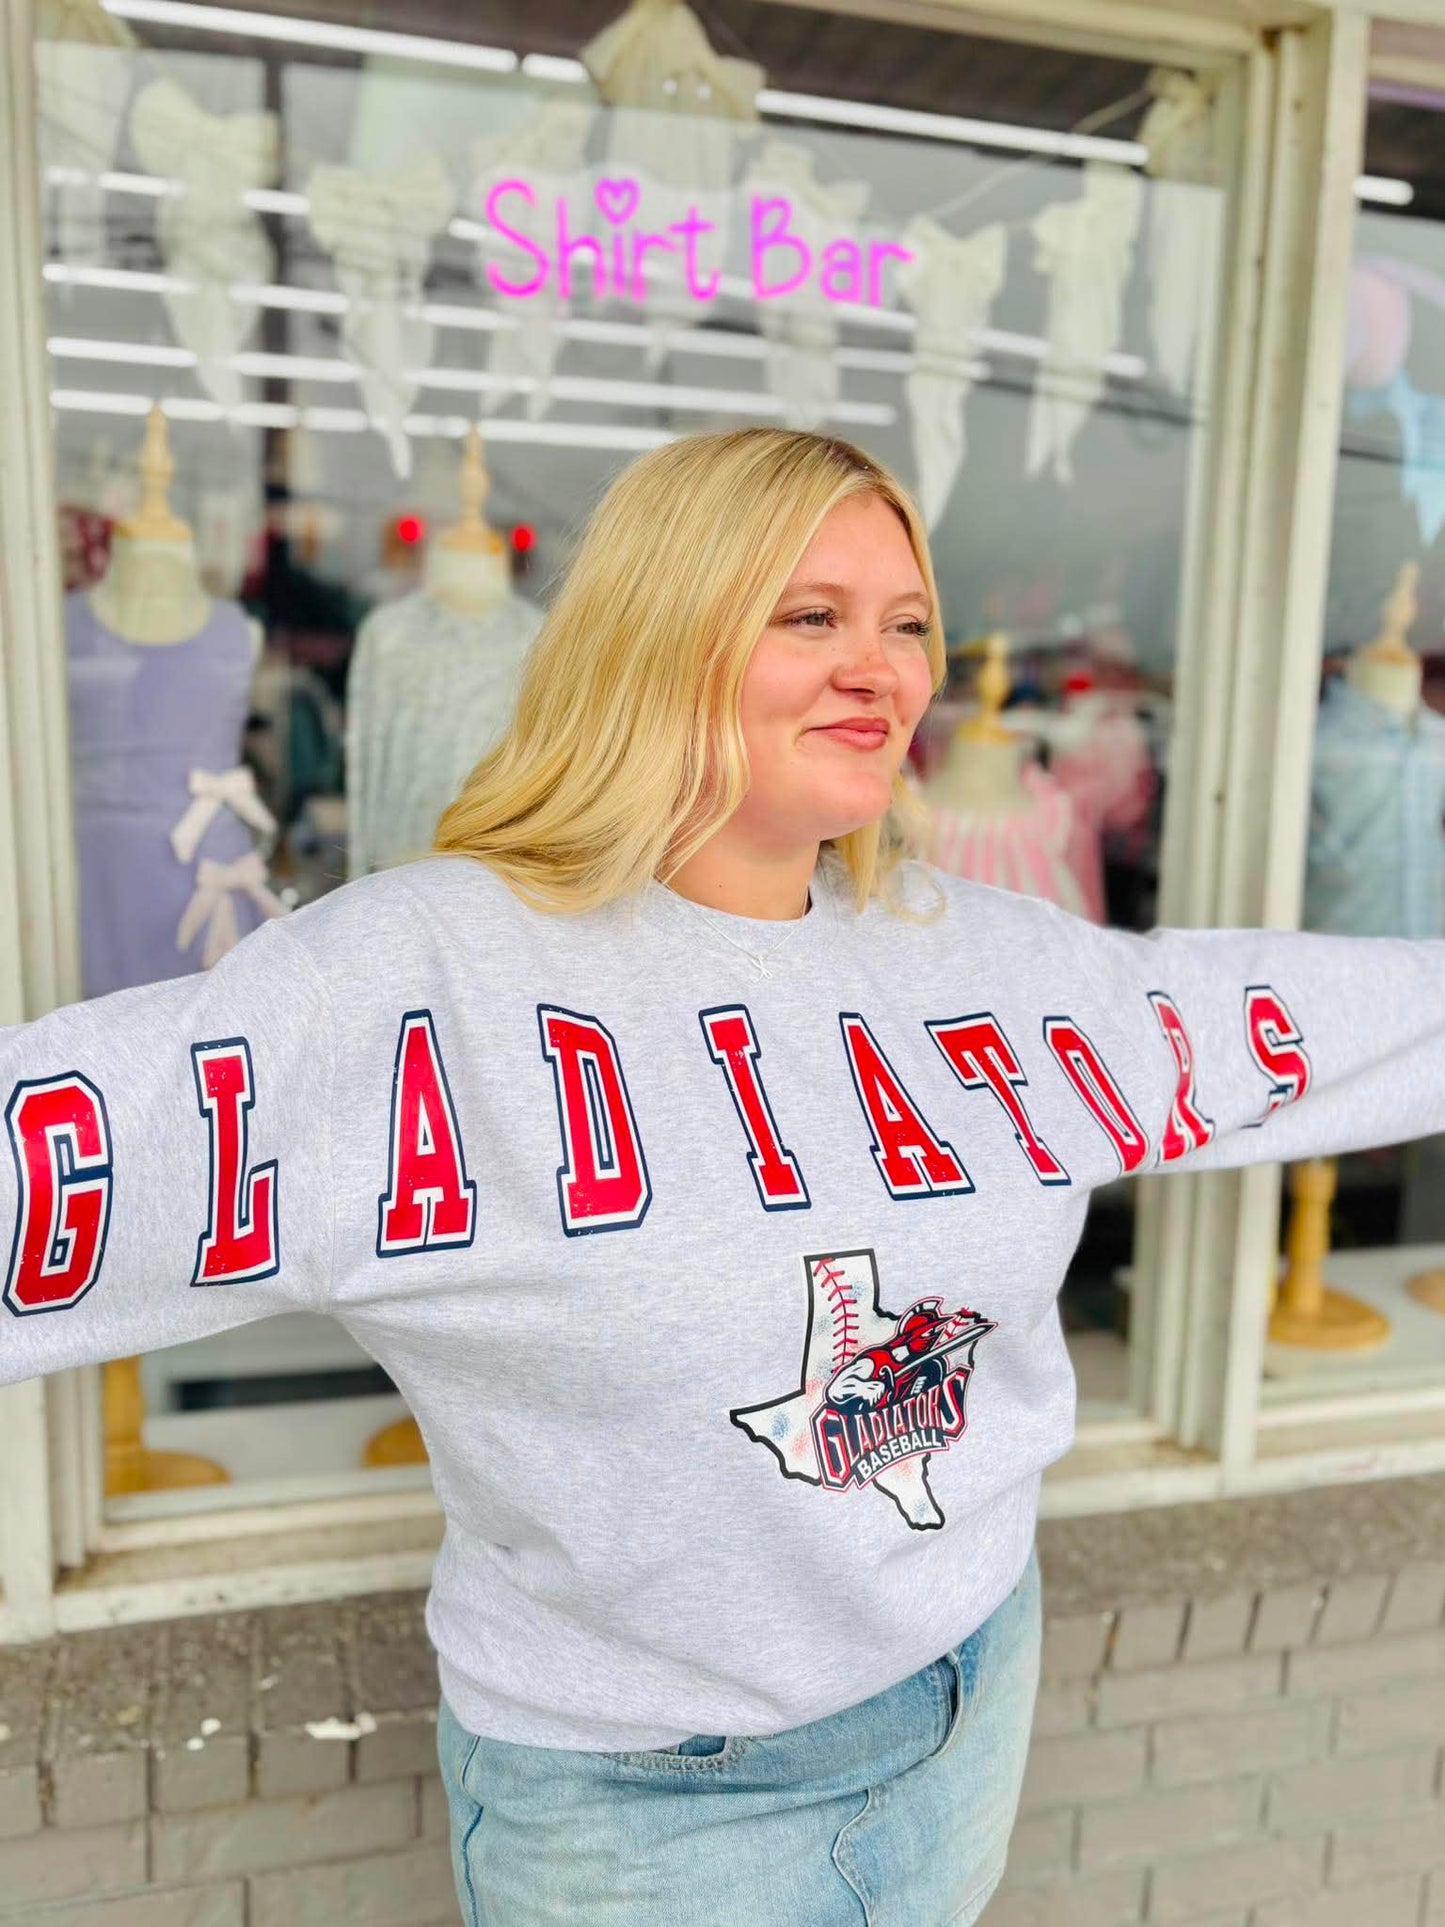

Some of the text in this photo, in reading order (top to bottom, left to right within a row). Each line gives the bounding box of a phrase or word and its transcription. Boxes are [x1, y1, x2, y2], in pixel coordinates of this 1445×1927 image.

[485, 177, 914, 307] Shirt Bar
[4, 985, 1312, 1316] GLADIATORS
[814, 1369, 970, 1487] GLADIATORS
[857, 1429, 943, 1479] BASEBALL
